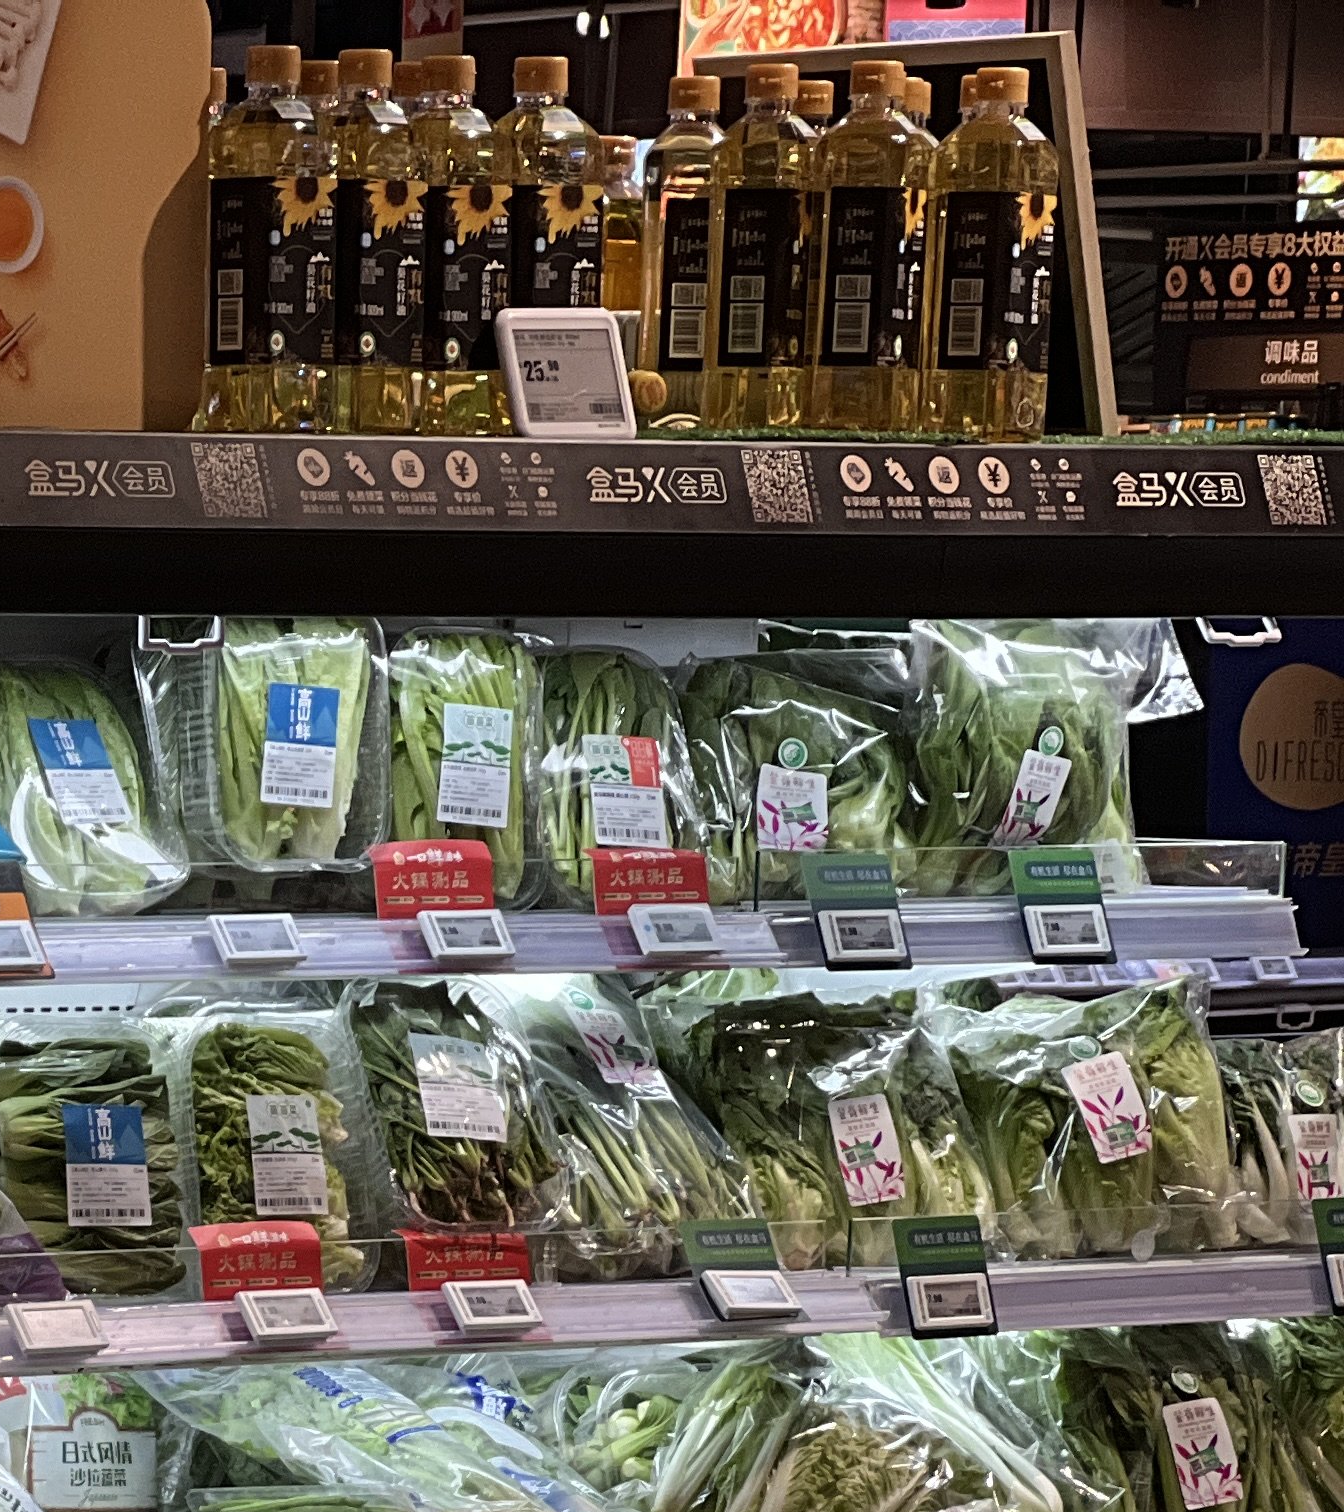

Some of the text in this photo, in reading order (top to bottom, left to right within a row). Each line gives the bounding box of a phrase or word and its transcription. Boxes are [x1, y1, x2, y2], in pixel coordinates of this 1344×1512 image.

[1264, 340, 1319, 364] 调味品
[1260, 369, 1320, 384] condiment
[392, 870, 470, 890] 火锅涮品
[609, 867, 684, 887] 火锅涮品
[218, 1250, 298, 1273] 火锅涮品
[61, 1440, 133, 1465] 日式风情
[70, 1468, 127, 1488] 沙拉蔬菜
